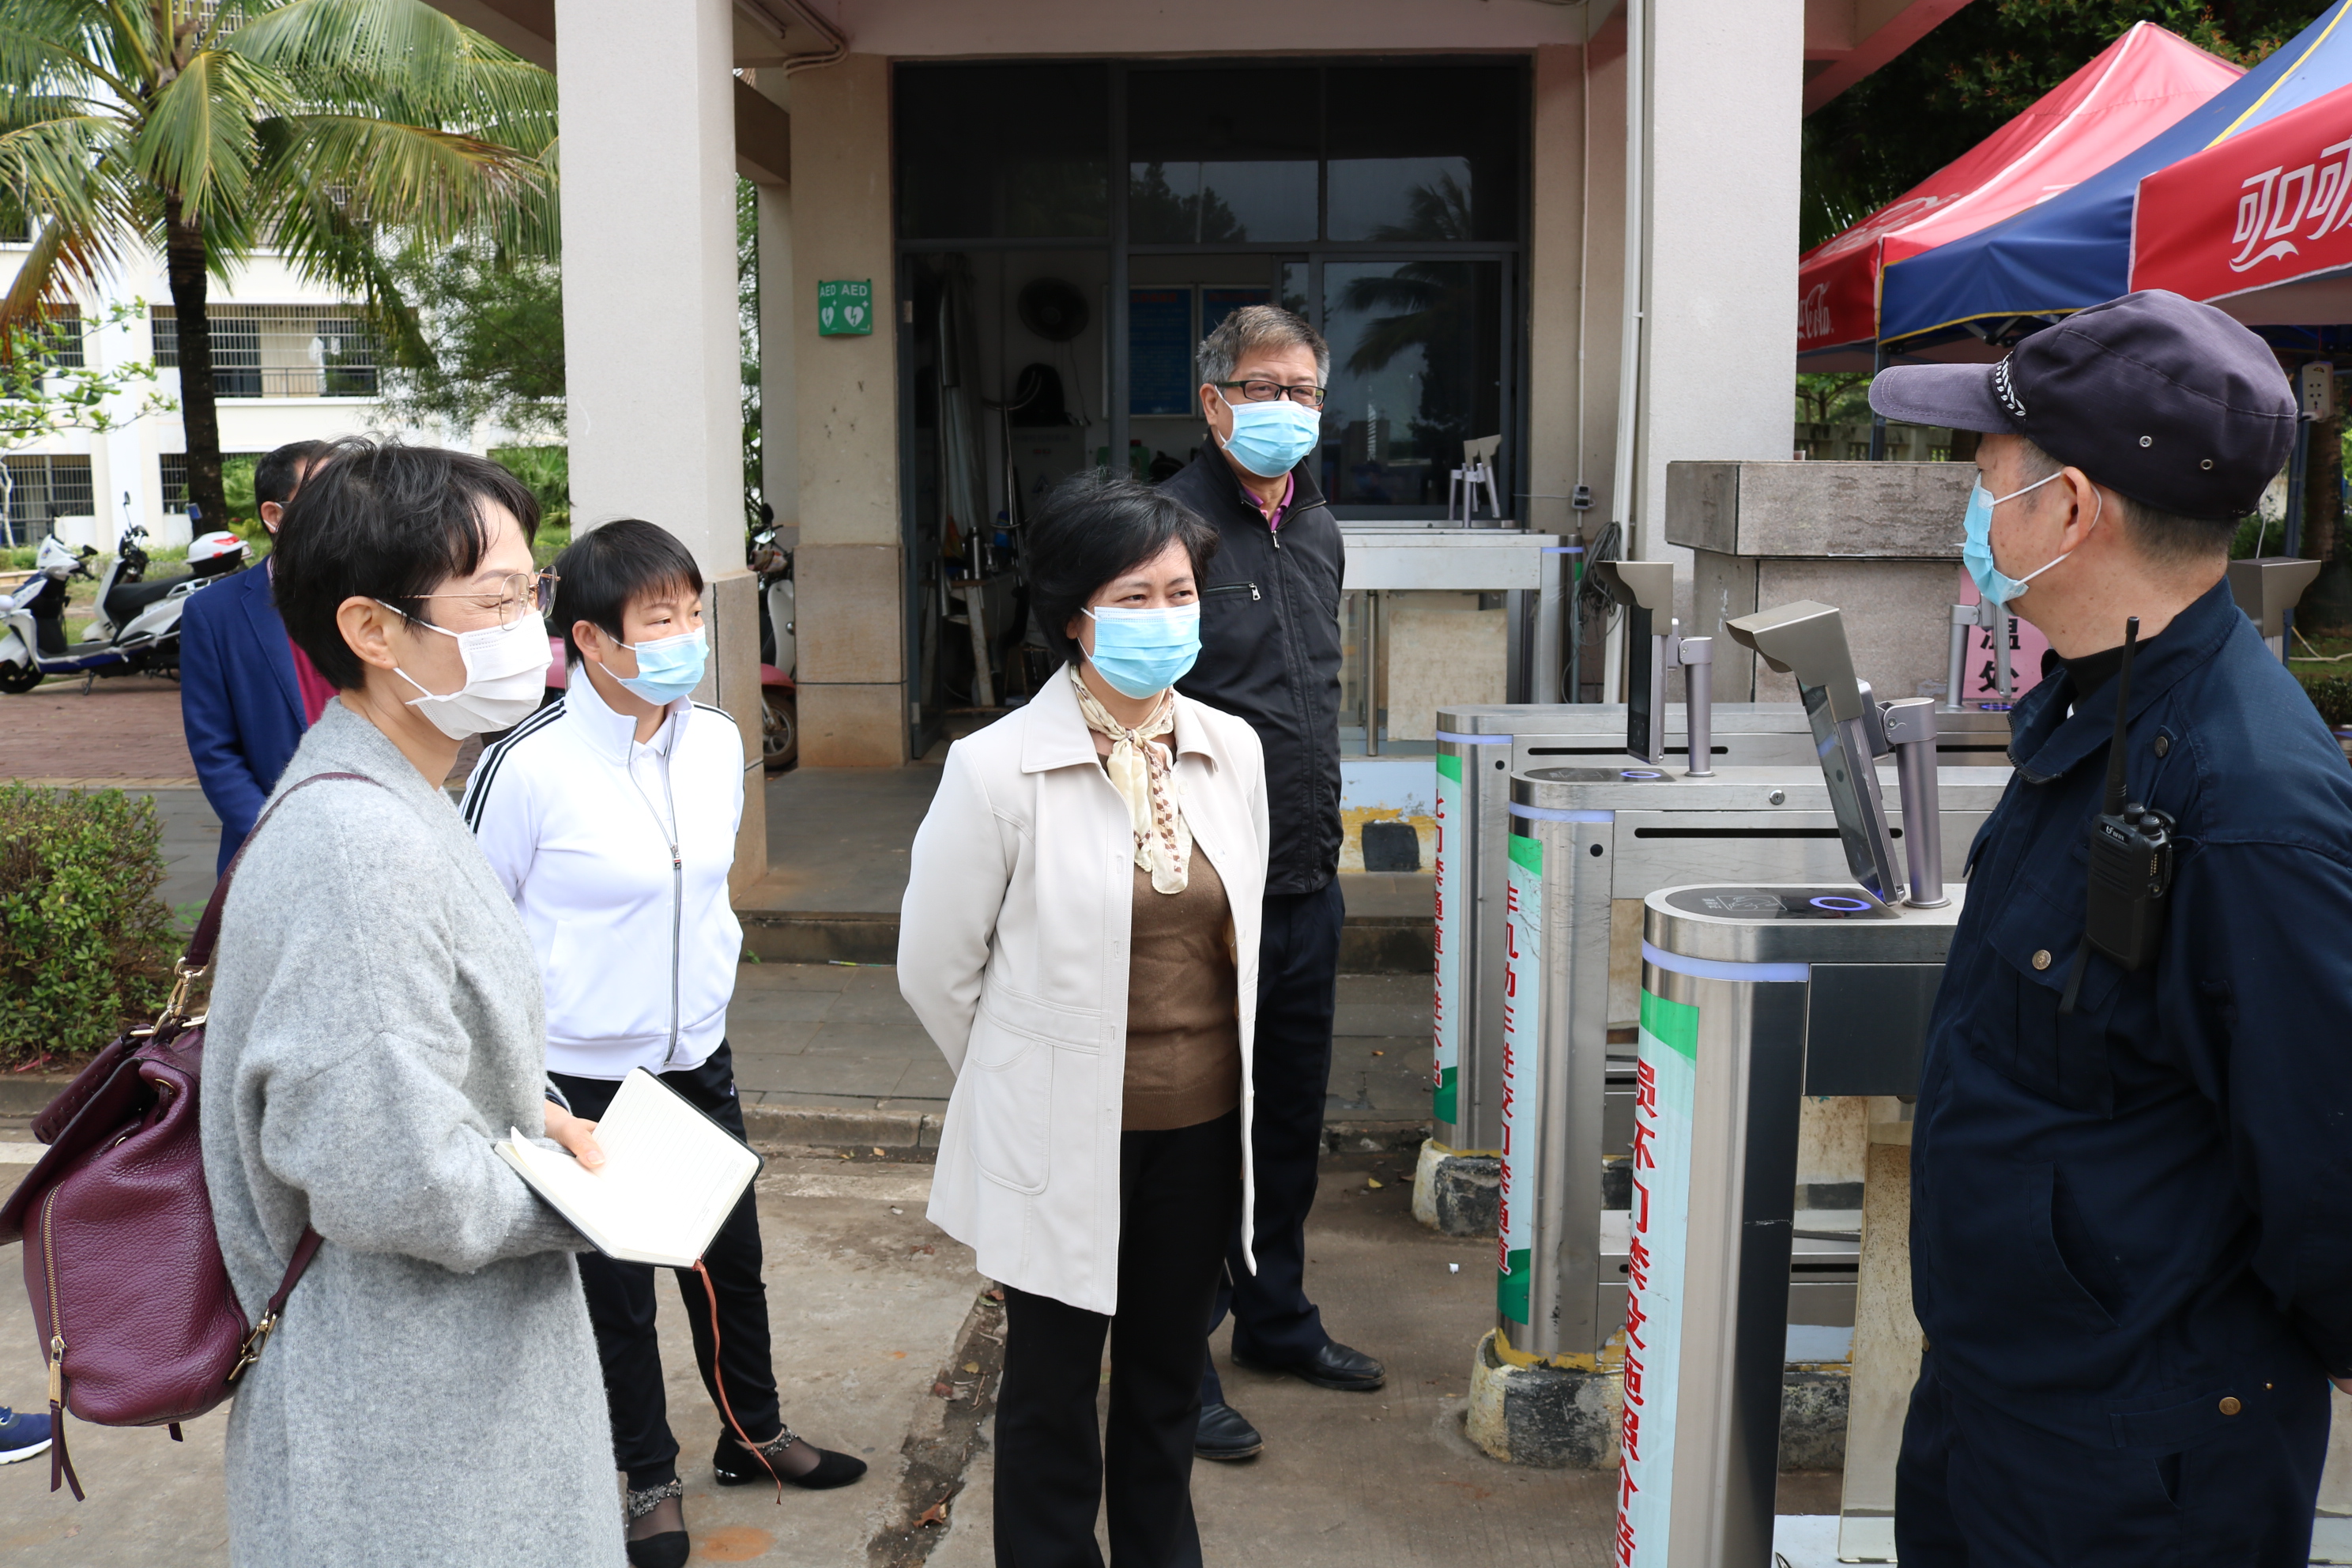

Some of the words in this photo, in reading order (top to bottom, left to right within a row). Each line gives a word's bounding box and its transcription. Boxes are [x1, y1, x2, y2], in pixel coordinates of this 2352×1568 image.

[2230, 135, 2352, 264] 可口可
[820, 285, 836, 297] AED
[841, 284, 868, 296] AED
